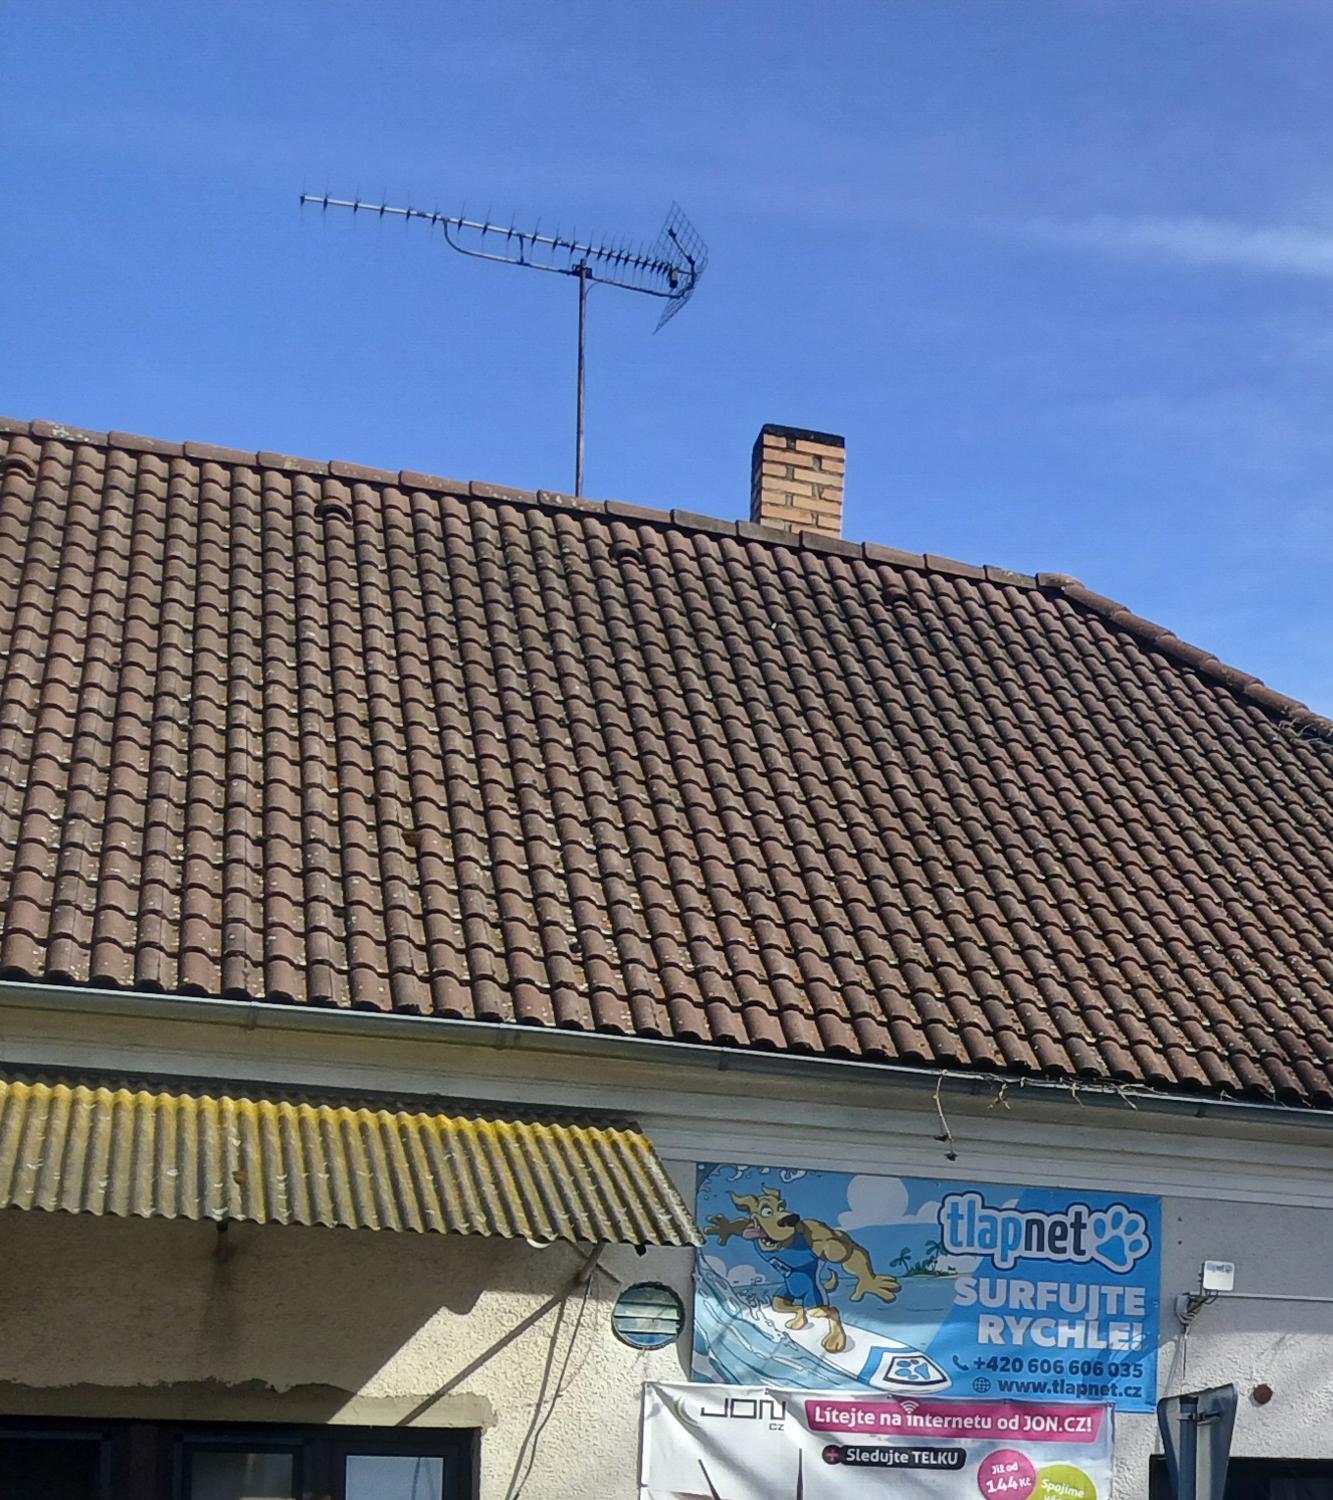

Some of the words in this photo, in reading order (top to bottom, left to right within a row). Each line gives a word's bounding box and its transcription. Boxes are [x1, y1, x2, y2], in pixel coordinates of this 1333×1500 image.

[946, 1199, 1087, 1263] tlapnet
[953, 1277, 1146, 1321] SURFUJTE
[977, 1314, 1144, 1351] RYCHLE!
[974, 1356, 1023, 1374] +420
[1027, 1358, 1064, 1375] 606
[1068, 1359, 1104, 1376] 606
[1108, 1362, 1143, 1379] 035
[997, 1379, 1143, 1398] www.tlapnet.cz
[700, 1397, 786, 1421] JON
[815, 1406, 878, 1428] Lítejte
[880, 1413, 901, 1427] na
[906, 1411, 992, 1430] internetu
[997, 1415, 1019, 1431] od
[1023, 1415, 1092, 1433] JON.CZ!
[846, 1448, 909, 1465] Sledujte
[911, 1451, 959, 1466] TELKU
[1005, 1461, 1019, 1472] od
[986, 1475, 1018, 1493] 144
